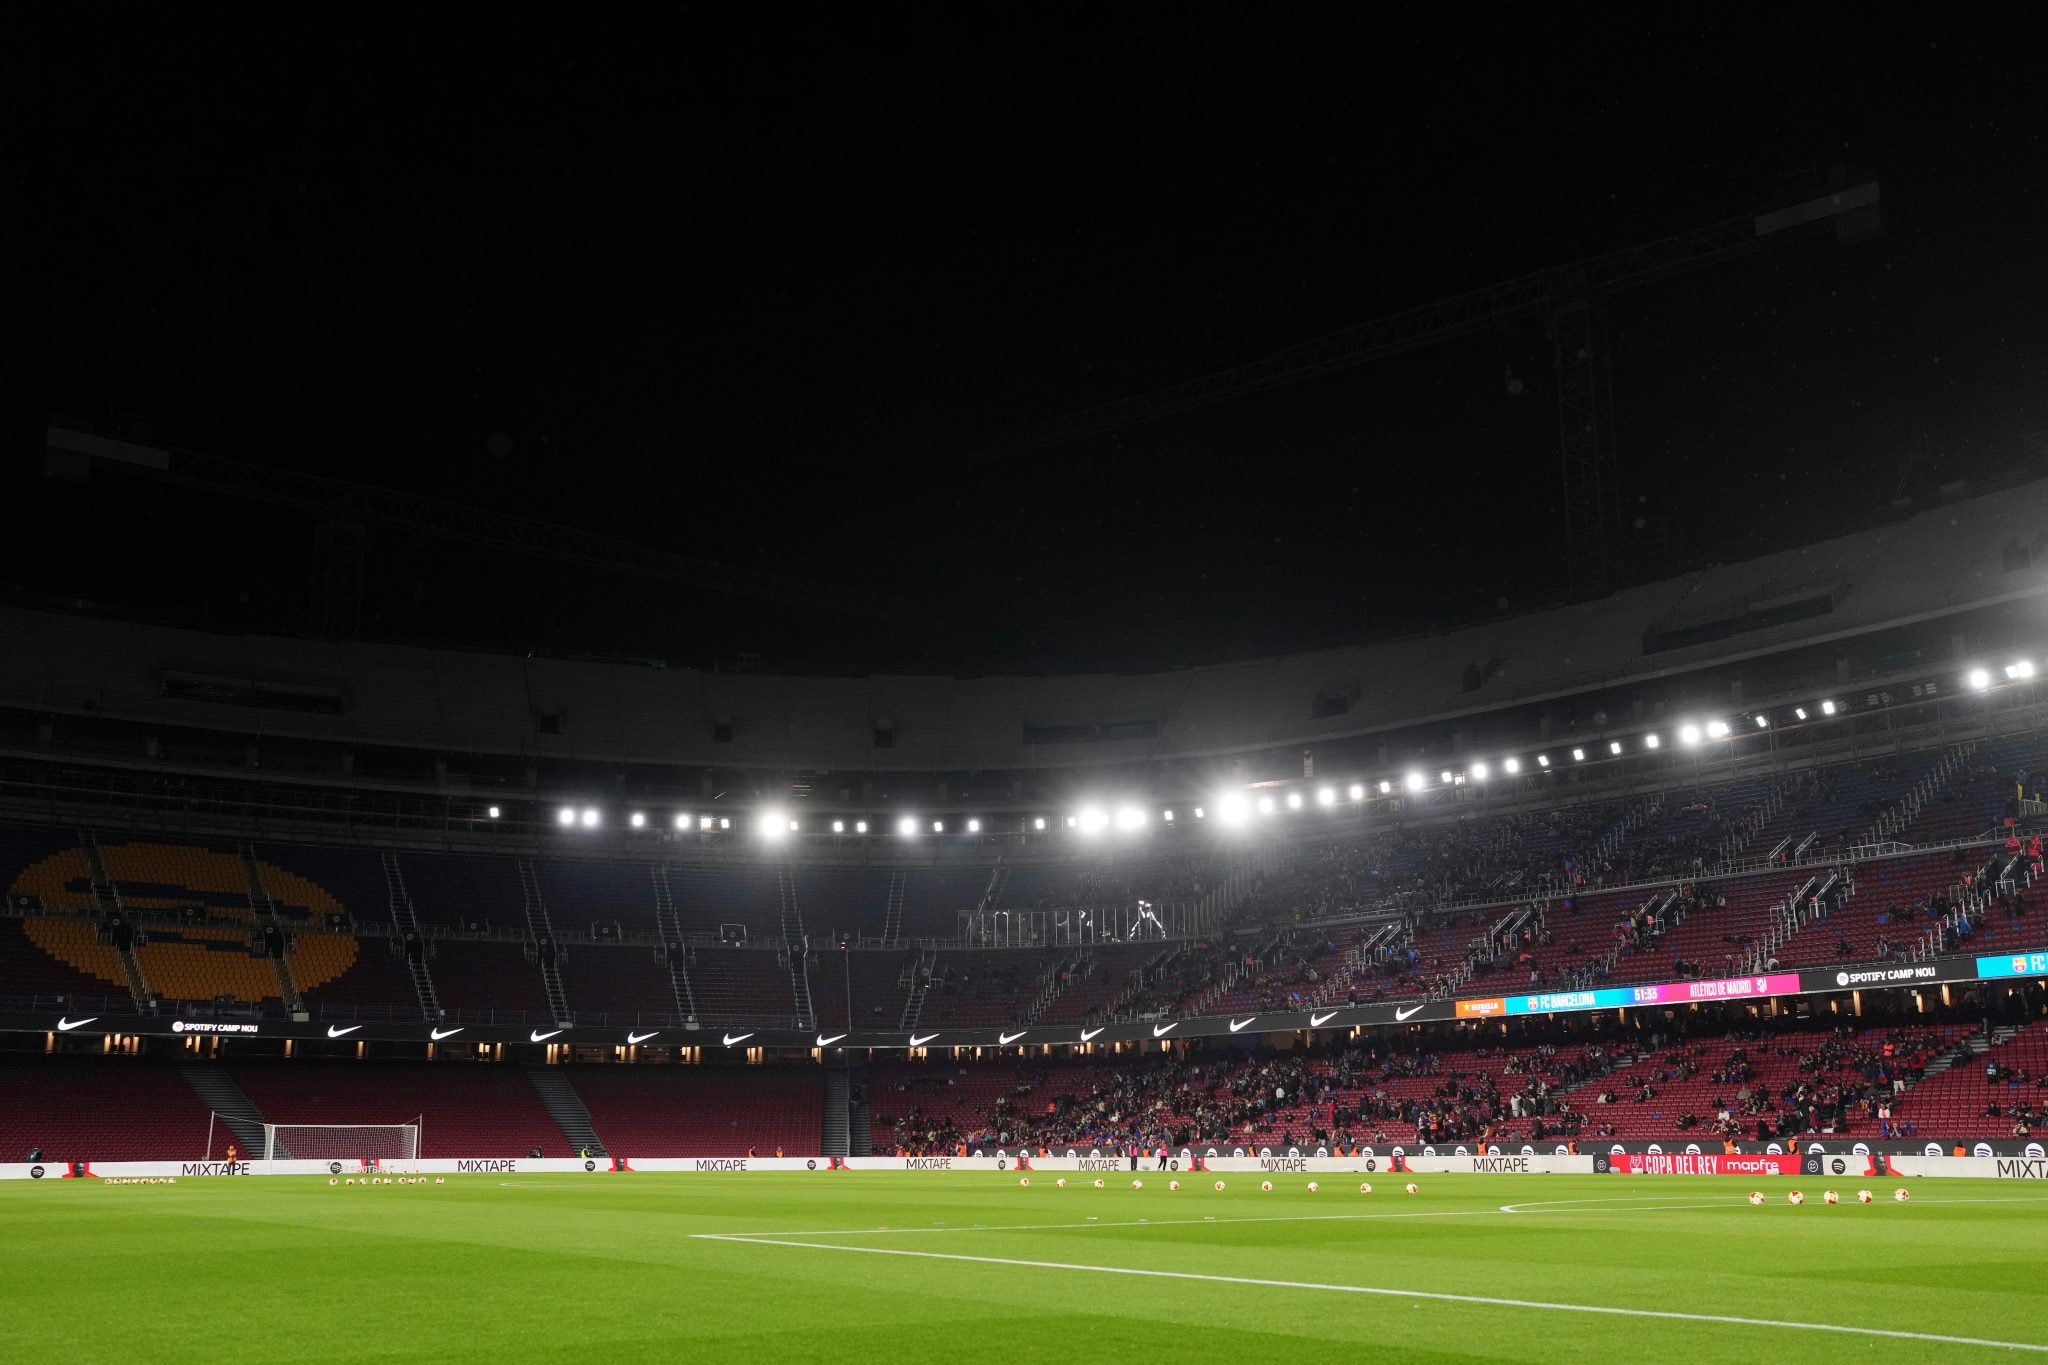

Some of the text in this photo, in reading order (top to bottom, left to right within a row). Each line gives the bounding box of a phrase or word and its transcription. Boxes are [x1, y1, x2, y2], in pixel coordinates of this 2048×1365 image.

[2031, 955, 2046, 971] FC
[1850, 967, 1936, 983] SPOTIFY CAMP NOU
[1690, 980, 1752, 997] ATLÉTICO DE MADRID
[1540, 992, 1596, 1009] FC BARCELONA
[184, 1023, 217, 1031] SPOTIFY
[218, 1024, 240, 1032] CAMP
[182, 1163, 250, 1176] MIXTAPE
[457, 1160, 516, 1172] MIXTAPE
[696, 1160, 747, 1171] MIXTAPE
[906, 1158, 951, 1169] MIXTAPE
[1078, 1160, 1119, 1171] MIXTAPE
[1260, 1159, 1307, 1172] MIXTAPE
[1473, 1158, 1529, 1172] MIXTAPE
[1645, 1155, 1717, 1174] COPA DEL REY
[1727, 1159, 1779, 1173] mapfre
[1997, 1160, 2048, 1178] MIXT
